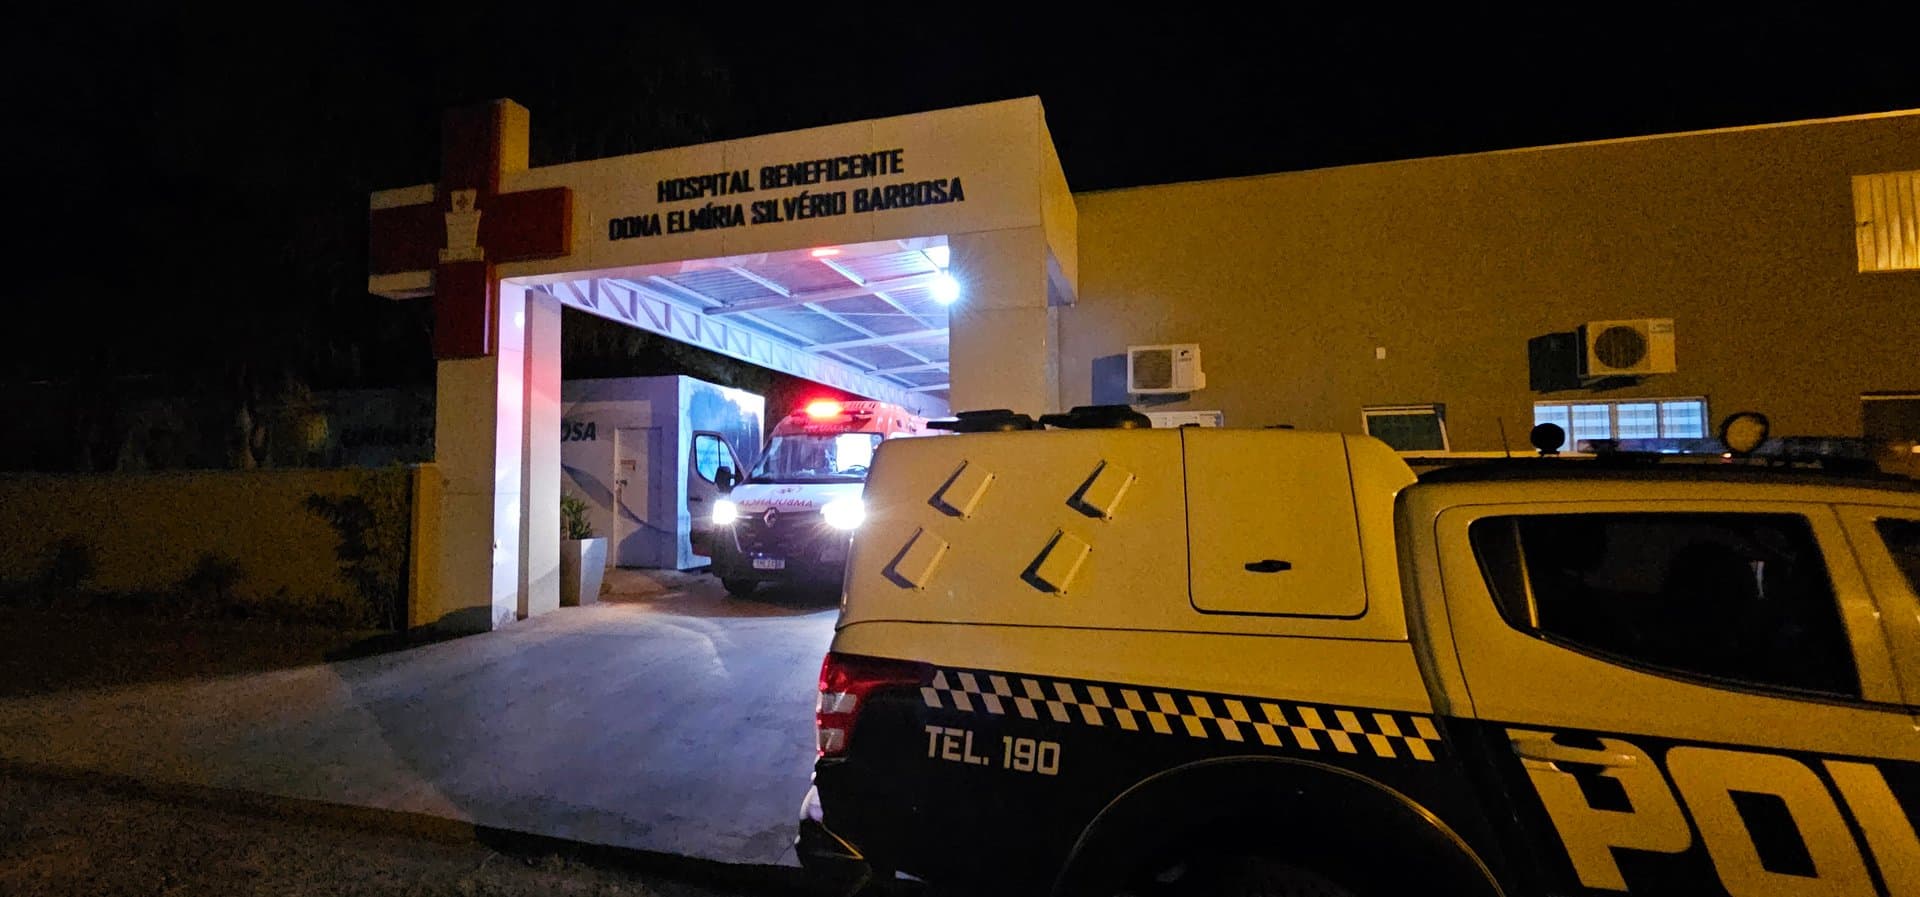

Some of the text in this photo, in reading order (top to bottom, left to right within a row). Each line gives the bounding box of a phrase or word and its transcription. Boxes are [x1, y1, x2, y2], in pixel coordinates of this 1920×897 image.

[657, 148, 904, 203] HOSPITAL BENEFICENTE
[608, 176, 965, 241] DONA ELMÍRIA SILVÉRIO BARBOSA
[925, 724, 1061, 776] TEL. 190
